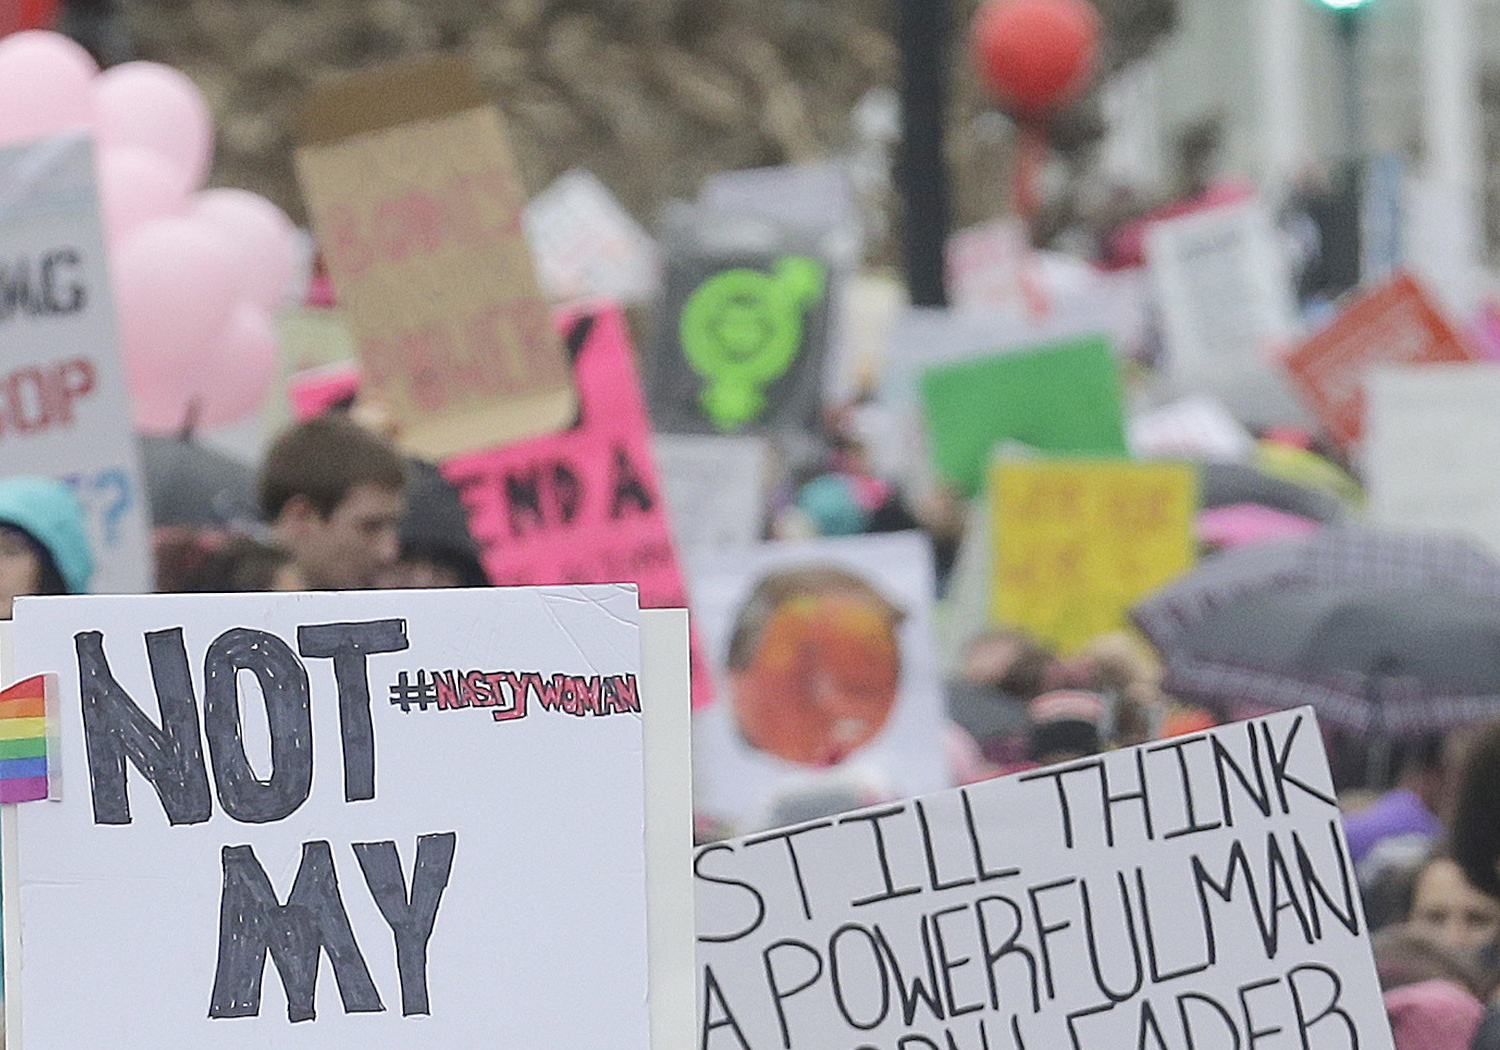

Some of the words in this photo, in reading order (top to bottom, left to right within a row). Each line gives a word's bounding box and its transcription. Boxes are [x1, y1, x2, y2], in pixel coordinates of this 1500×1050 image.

[74, 619, 409, 826] NOT
[693, 788, 1020, 942] STILL
[1019, 715, 1339, 849] THINK
[208, 832, 456, 1022] MY
[762, 867, 1210, 1049] POWERFUL
[1192, 820, 1360, 965] MAN
